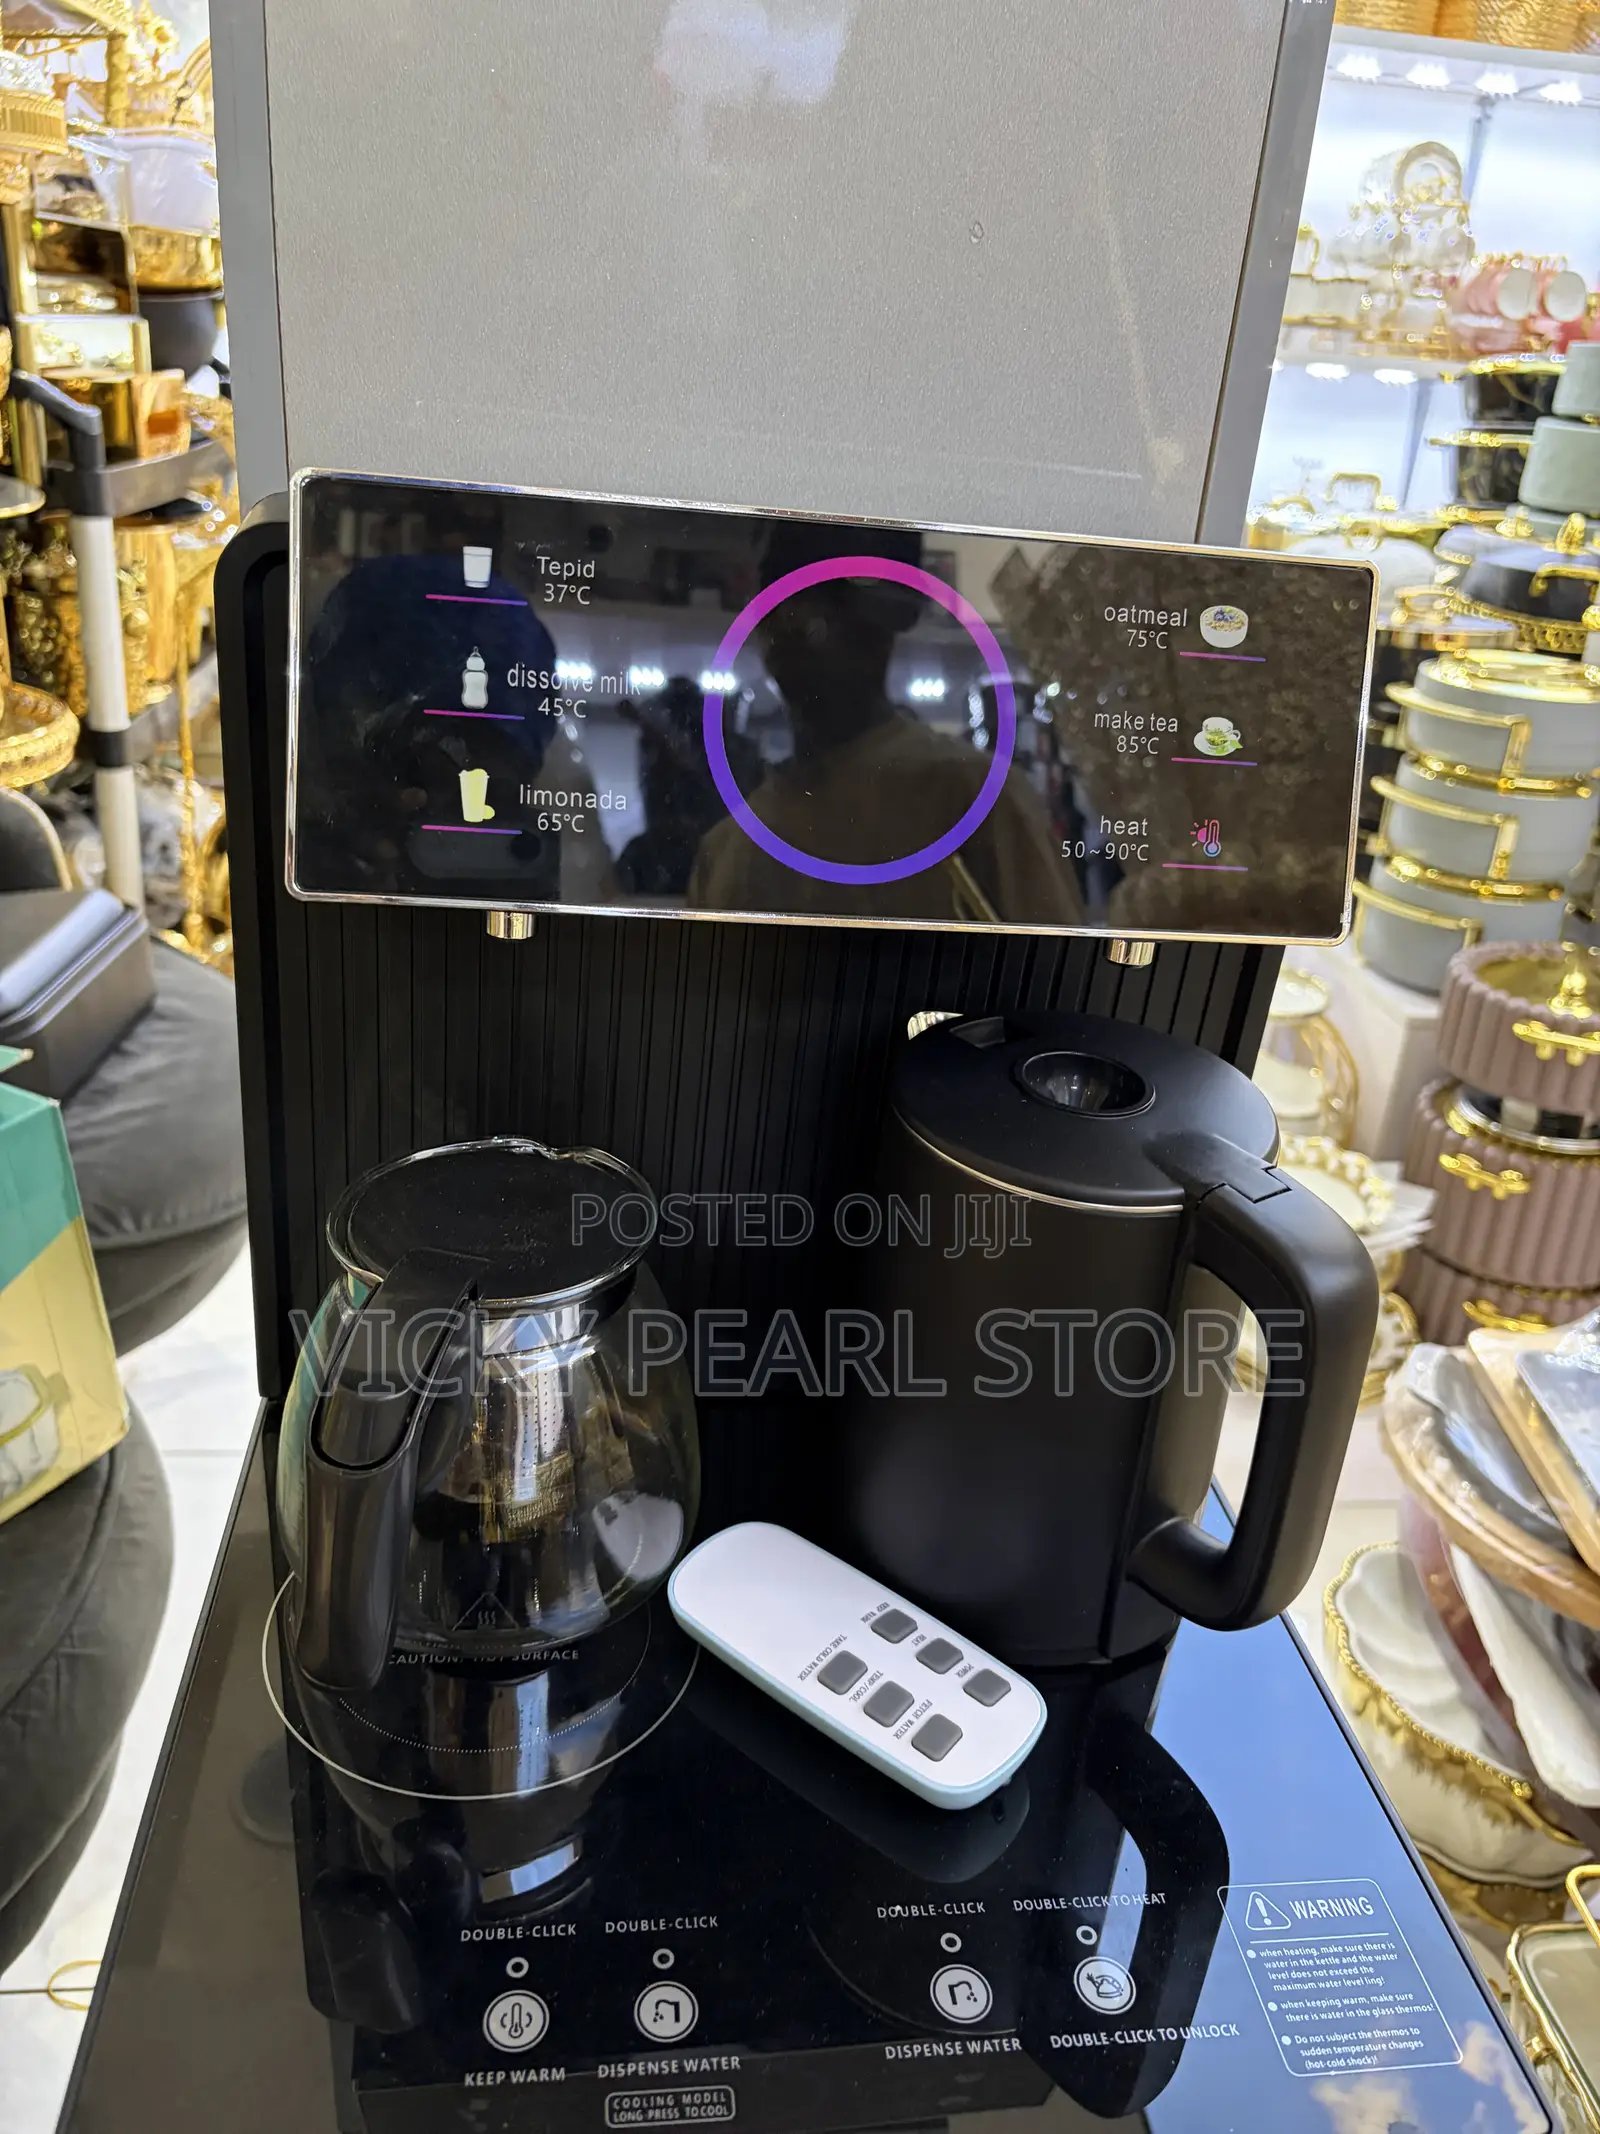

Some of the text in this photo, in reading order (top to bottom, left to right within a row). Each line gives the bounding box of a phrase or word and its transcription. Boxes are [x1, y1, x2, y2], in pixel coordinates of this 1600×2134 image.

[536, 556, 595, 579] Tepid
[543, 583, 591, 605] 37°C
[1103, 604, 1188, 627] oatmeal
[1127, 629, 1168, 649] 75°C
[538, 697, 587, 718] 45°C
[1094, 711, 1178, 732] make tea
[1116, 735, 1159, 755] 85°C
[519, 784, 627, 810] limonada
[537, 812, 585, 832] 65°C
[1099, 815, 1148, 835] heat
[815, 1646, 833, 1662] COLD
[797, 1661, 819, 1681] WATER
[893, 1699, 933, 1740] FETCH WATER
[876, 1902, 986, 1919] DOUBLE-CLICK
[1013, 1892, 1166, 1911] DOUBLE-CLICK TO HEAT
[1289, 1896, 1375, 1920] WARNING
[461, 1923, 577, 1942] DOUBLE-CLICK
[605, 1915, 719, 1934] DOUBLE-CLICK
[1259, 1949, 1283, 1958] when
[1321, 1944, 1343, 1954] make
[1364, 1942, 1386, 1951] there
[1387, 1941, 1396, 1949] is
[1264, 1953, 1398, 1969] water in the kettle and the water
[1268, 1965, 1375, 1980] level does not exceed the
[1273, 1982, 1317, 1992] maximum
[1318, 1979, 1342, 1988] water
[1343, 1977, 1364, 1986] level
[1280, 1999, 1305, 2010] when
[1305, 1997, 1342, 2008] keeping
[1370, 1993, 1394, 2003] make
[1395, 1993, 1414, 2001] sure
[1285, 2012, 1310, 2022] there
[1311, 2011, 1319, 2020] is
[1320, 2010, 1345, 2020] water
[1346, 2008, 1355, 2018] in
[1356, 2007, 1371, 2017] the
[1372, 2006, 1395, 2018] glass
[1050, 2023, 1240, 2049] DOUBLE-CLICK TO UNLOCK
[1294, 2026, 1421, 2044] Do not subject the thermos to
[885, 2037, 1022, 2060] DISPENSE WATER
[1300, 2039, 1424, 2056] sudden temperature changes
[464, 2067, 566, 2087] KEEP WARM
[597, 2056, 741, 2078] DISPENSE WATER
[613, 2091, 727, 2110] COOLING MODEL
[613, 2110, 643, 2123] LONG
[648, 2107, 680, 2120] PRESS
